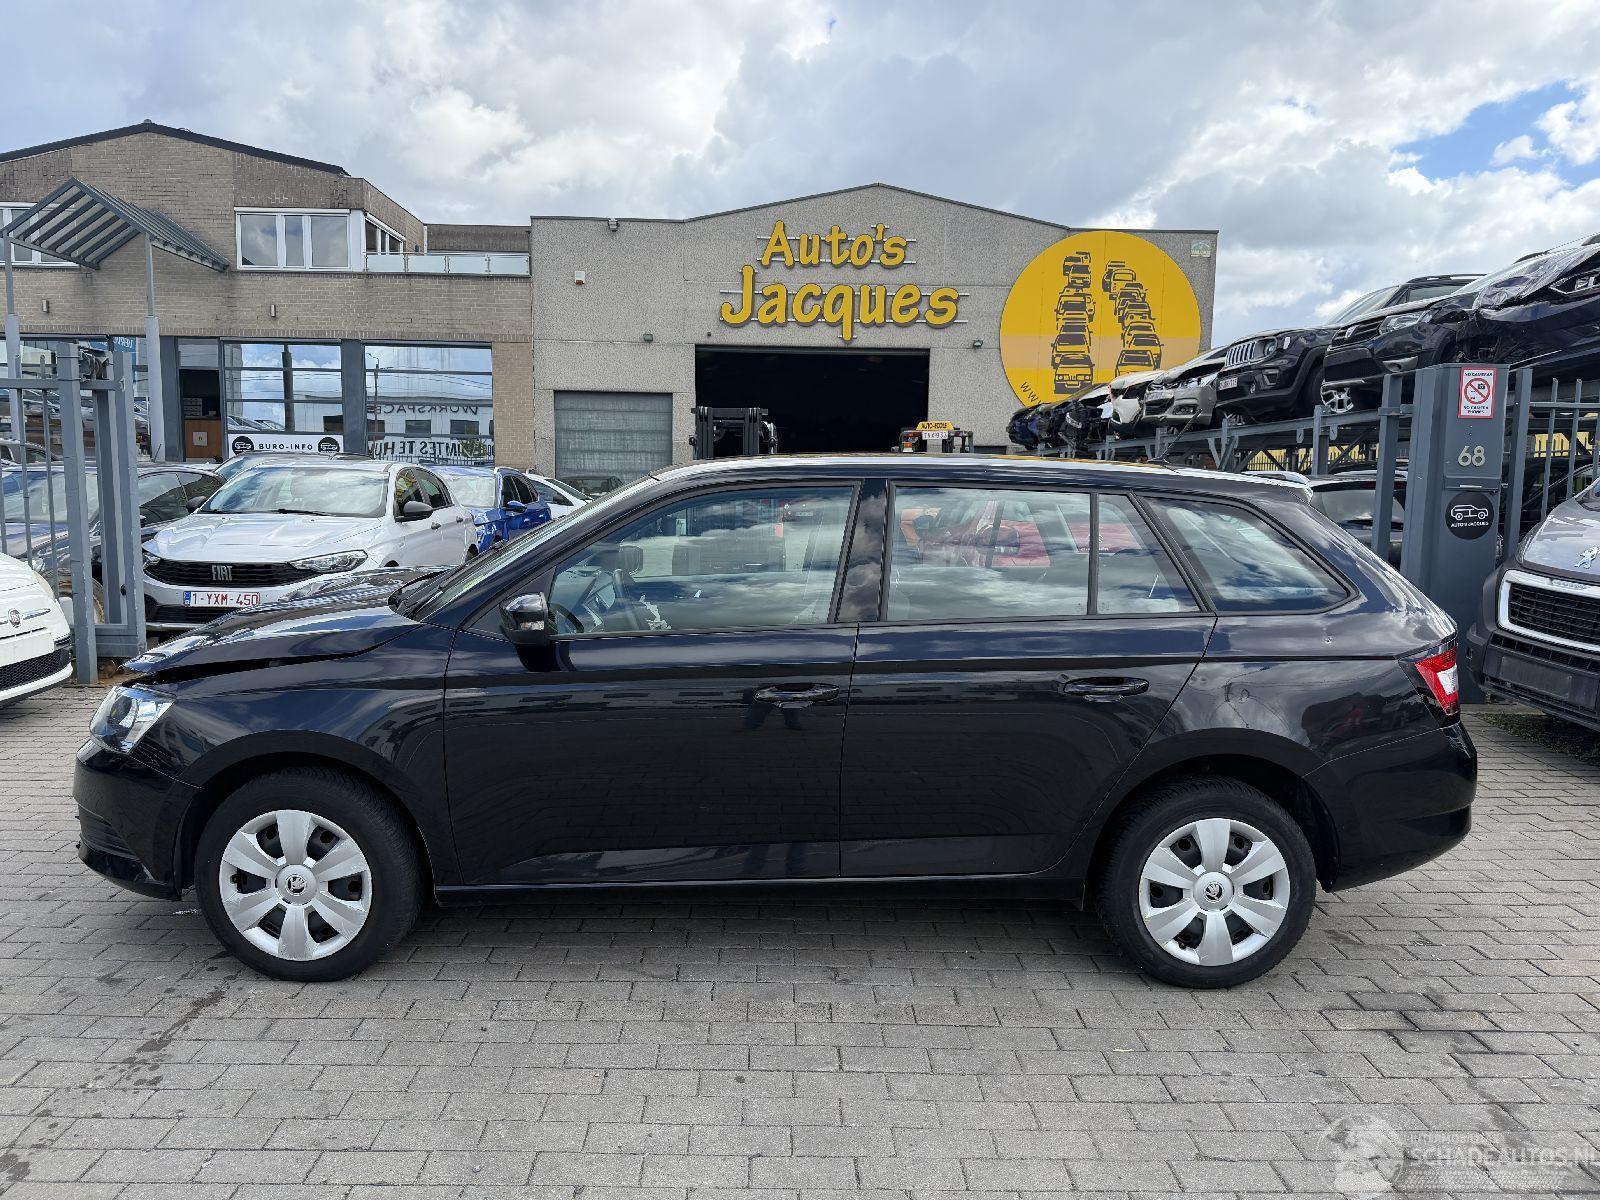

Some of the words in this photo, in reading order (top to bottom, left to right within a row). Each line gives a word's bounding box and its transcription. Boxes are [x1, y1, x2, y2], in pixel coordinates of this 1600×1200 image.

[761, 219, 908, 269] Auto's
[720, 264, 961, 342] Jacques
[258, 443, 313, 451] BURO-INFO
[1458, 445, 1486, 467] 68
[211, 564, 233, 581] FIAT
[192, 592, 259, 607] 1-YXM-450
